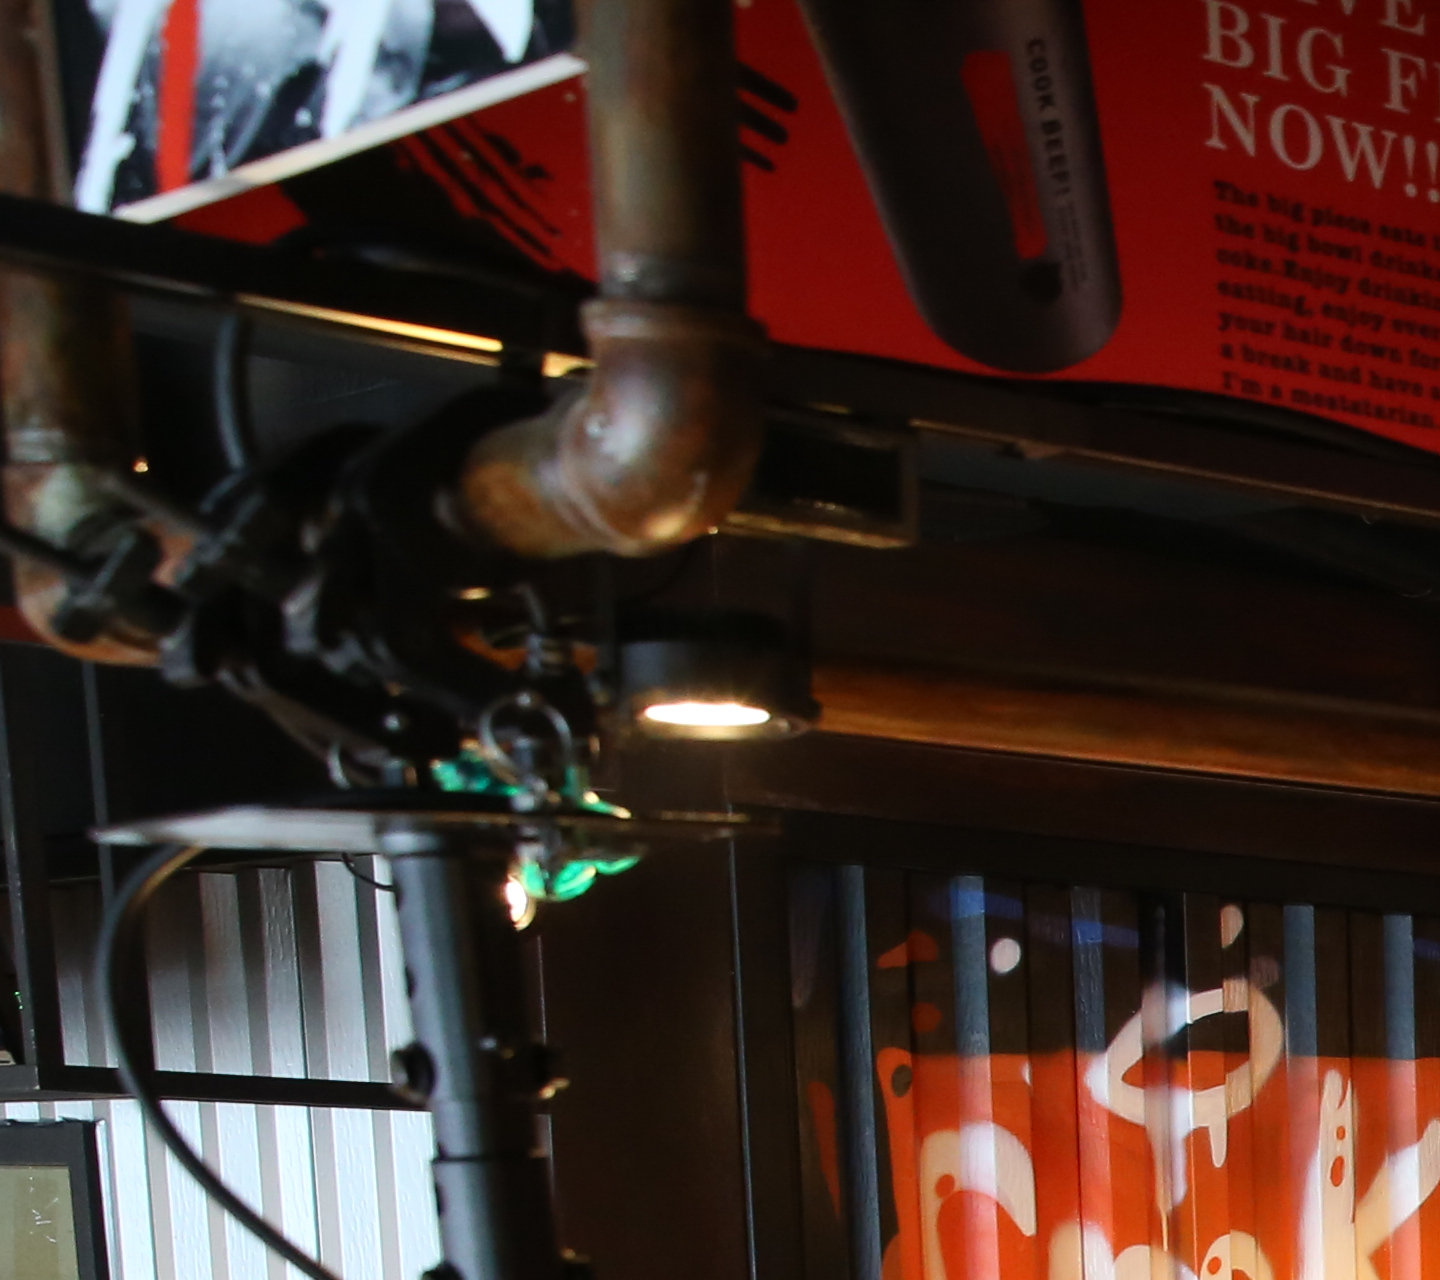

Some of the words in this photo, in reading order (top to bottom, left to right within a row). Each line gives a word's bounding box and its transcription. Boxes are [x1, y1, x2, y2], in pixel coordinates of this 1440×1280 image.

[1203, 0, 1352, 97] BIG
[1213, 179, 1259, 208] The
[1266, 194, 1303, 223] big
[1214, 212, 1256, 239] the
[1262, 224, 1300, 253] big
[1307, 235, 1363, 263] bowl
[1219, 310, 1276, 335] your
[1283, 322, 1334, 347] hair
[1341, 336, 1403, 363] down
[1322, 301, 1384, 331] enjoy
[1240, 344, 1311, 375] break
[1317, 362, 1362, 385] and
[1370, 372, 1424, 397] have
